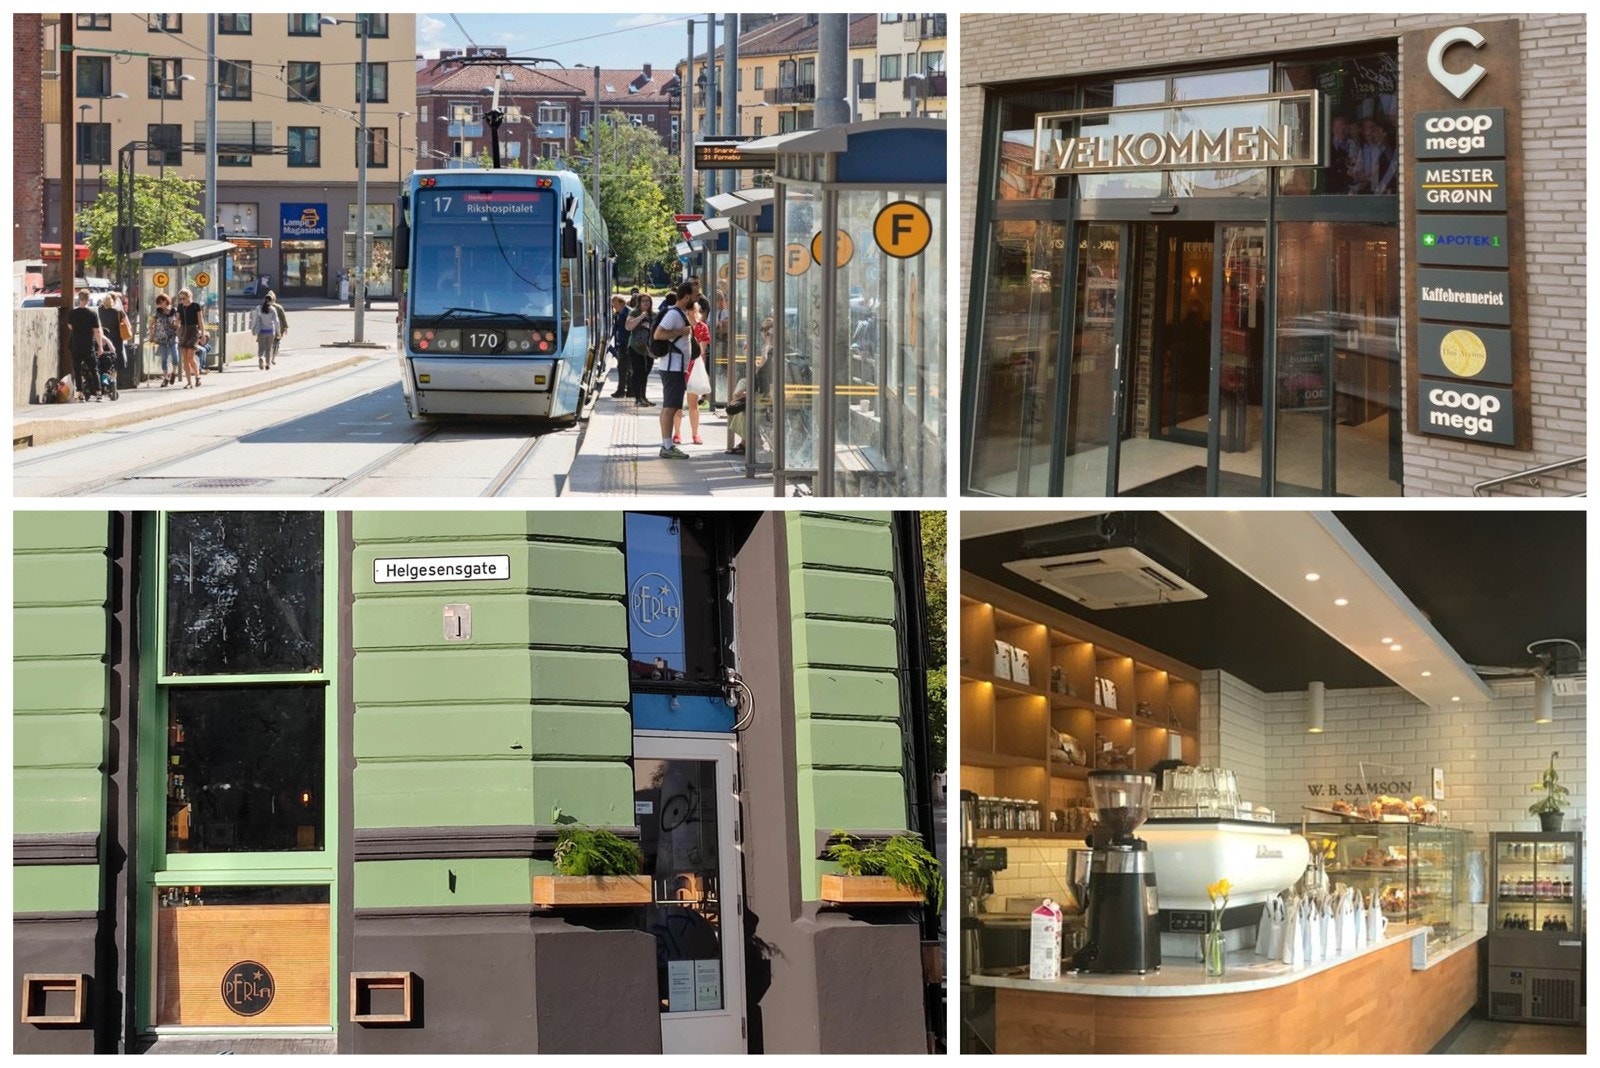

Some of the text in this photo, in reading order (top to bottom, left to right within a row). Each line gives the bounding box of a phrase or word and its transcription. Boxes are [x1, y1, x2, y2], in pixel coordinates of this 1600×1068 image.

[1425, 114, 1493, 134] coop
[1054, 124, 1288, 169] VELKOMMEN
[1425, 135, 1486, 154] mega
[1425, 168, 1494, 183] MESTER
[434, 197, 452, 212] 17
[1426, 189, 1493, 204] GRØNN
[467, 204, 534, 214] Rikshospitalet
[283, 219, 310, 227] Lampe
[283, 227, 324, 235] Magasinet
[892, 214, 914, 245] F
[1436, 235, 1500, 247] APOTEK 1
[788, 250, 801, 268] F
[158, 275, 164, 284] C
[200, 274, 206, 284] C
[1422, 286, 1504, 306] Kaffebrenneriet
[470, 334, 498, 348] 170
[1429, 388, 1500, 416] coop
[1430, 410, 1493, 436] mega
[386, 562, 497, 580] Helgesensgate
[634, 586, 678, 623] PERLA
[1307, 781, 1412, 796] W. B. SAMSON
[226, 973, 271, 1005] PERLA
